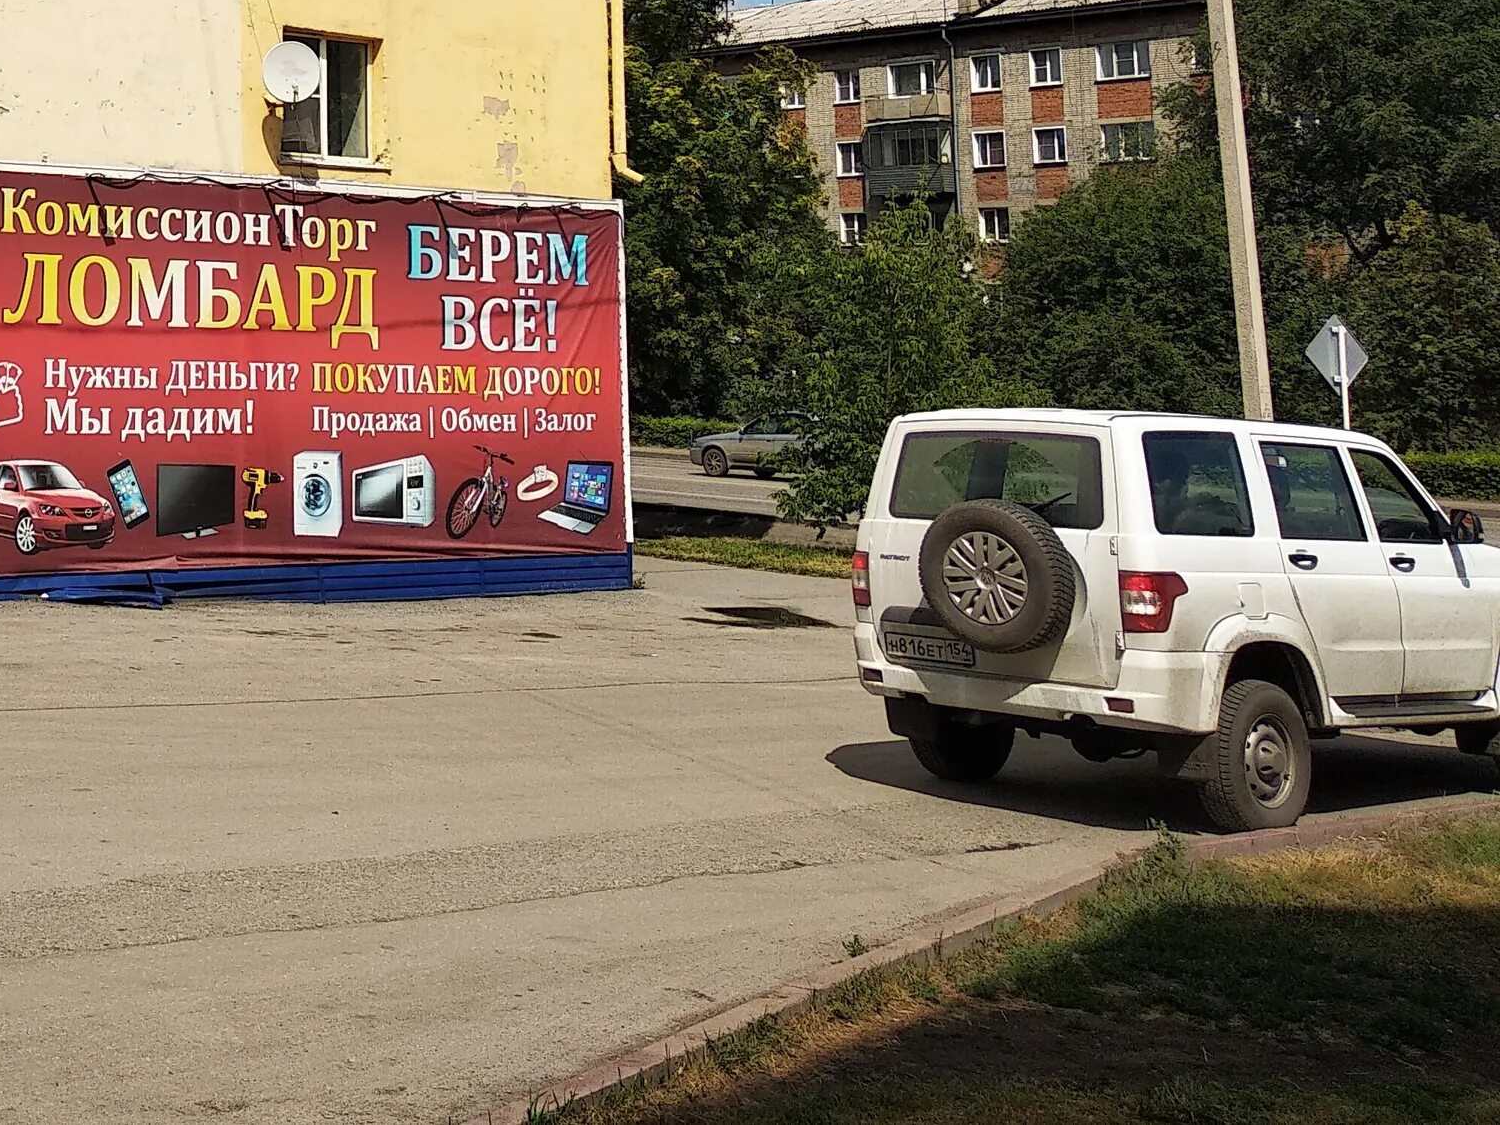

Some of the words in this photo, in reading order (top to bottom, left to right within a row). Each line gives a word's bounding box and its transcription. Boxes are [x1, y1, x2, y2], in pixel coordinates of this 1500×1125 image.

[0, 186, 377, 263] КомиссионТорг
[406, 224, 590, 286] БЕРЕМ
[2, 252, 380, 351] ЛОМБАРД
[440, 287, 559, 353] ВСЁ!
[43, 357, 160, 396] Нужны
[164, 360, 301, 397] ДЕНЬГИ?
[311, 362, 477, 395] ПОКУПАЕМ
[482, 365, 601, 401] ДОРОГО!
[43, 397, 113, 436] Мы
[119, 398, 255, 443] дадим!
[311, 405, 423, 439] Продажа
[440, 406, 517, 433] Обмен
[533, 407, 597, 433] Залог
[880, 554, 911, 562] PATRIOT
